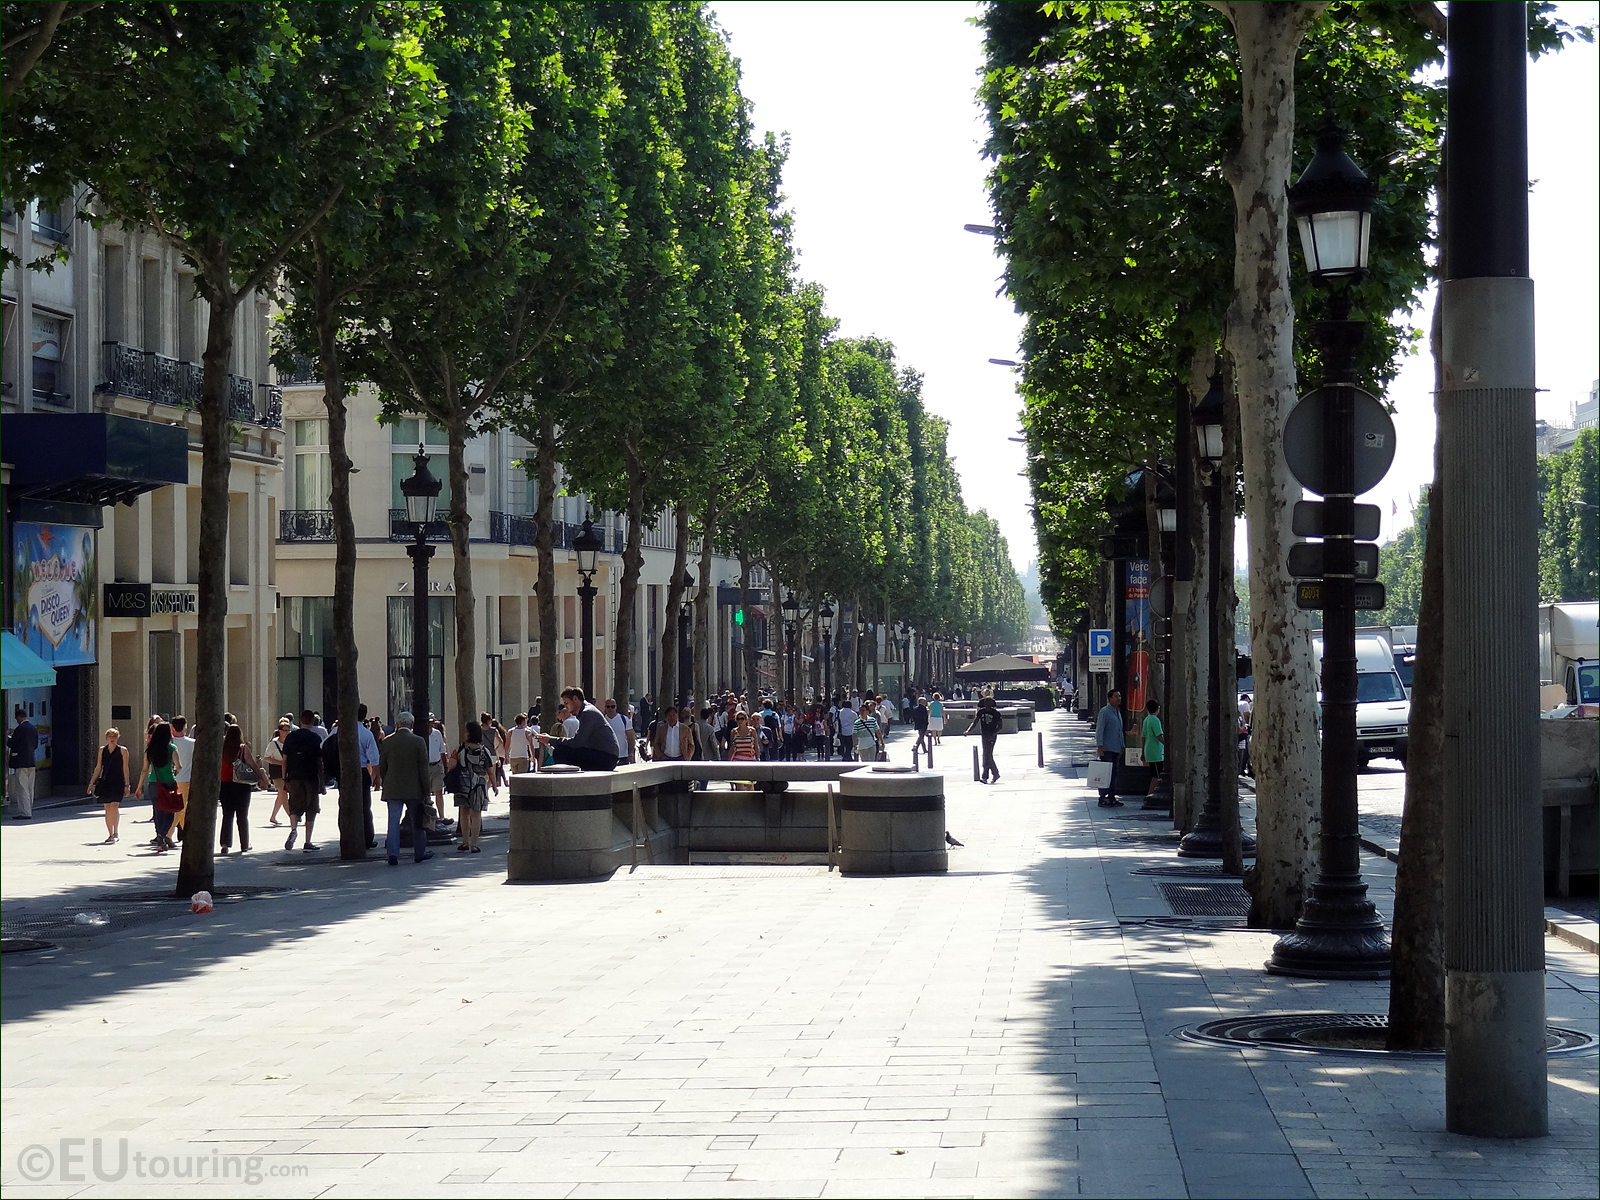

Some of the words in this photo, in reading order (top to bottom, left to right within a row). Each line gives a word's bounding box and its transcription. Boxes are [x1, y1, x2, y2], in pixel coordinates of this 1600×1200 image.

[398, 582, 455, 592] ZRA
[41, 593, 60, 615] DISCO
[108, 592, 146, 609] M&S
[50, 601, 71, 626] QUEEN
[1097, 635, 1110, 652] P
